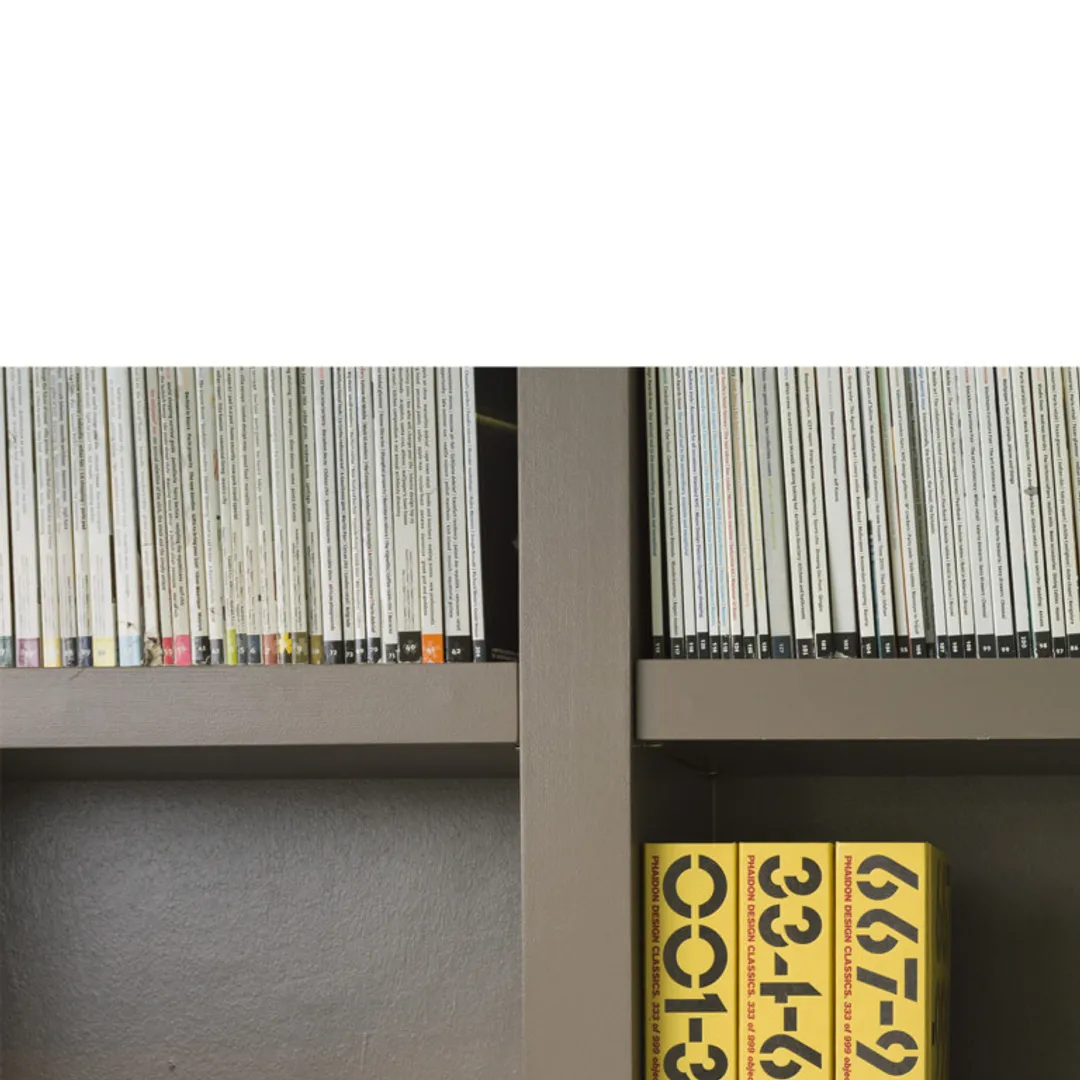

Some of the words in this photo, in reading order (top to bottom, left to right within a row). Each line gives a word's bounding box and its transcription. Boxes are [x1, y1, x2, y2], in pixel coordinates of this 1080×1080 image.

[651, 856, 660, 902] PHAIDON
[747, 855, 756, 901] PHAIDON
[843, 856, 852, 902] PHAIDON
[651, 905, 660, 943] DESIGN
[747, 904, 756, 942] DESIGN
[843, 905, 852, 943] DESIGN
[651, 946, 660, 998] CLASSICS.
[747, 945, 756, 998] CLASSICS.
[843, 946, 852, 998] CLASSICS.
[651, 1002, 660, 1020] 333
[747, 1001, 756, 1019] 333
[843, 1002, 852, 1020] 333
[651, 1023, 660, 1032] of
[747, 1023, 756, 1032] of
[843, 1023, 852, 1032] of
[651, 1036, 660, 1054] 999
[747, 1035, 756, 1053] 999
[843, 1036, 852, 1054] 999
